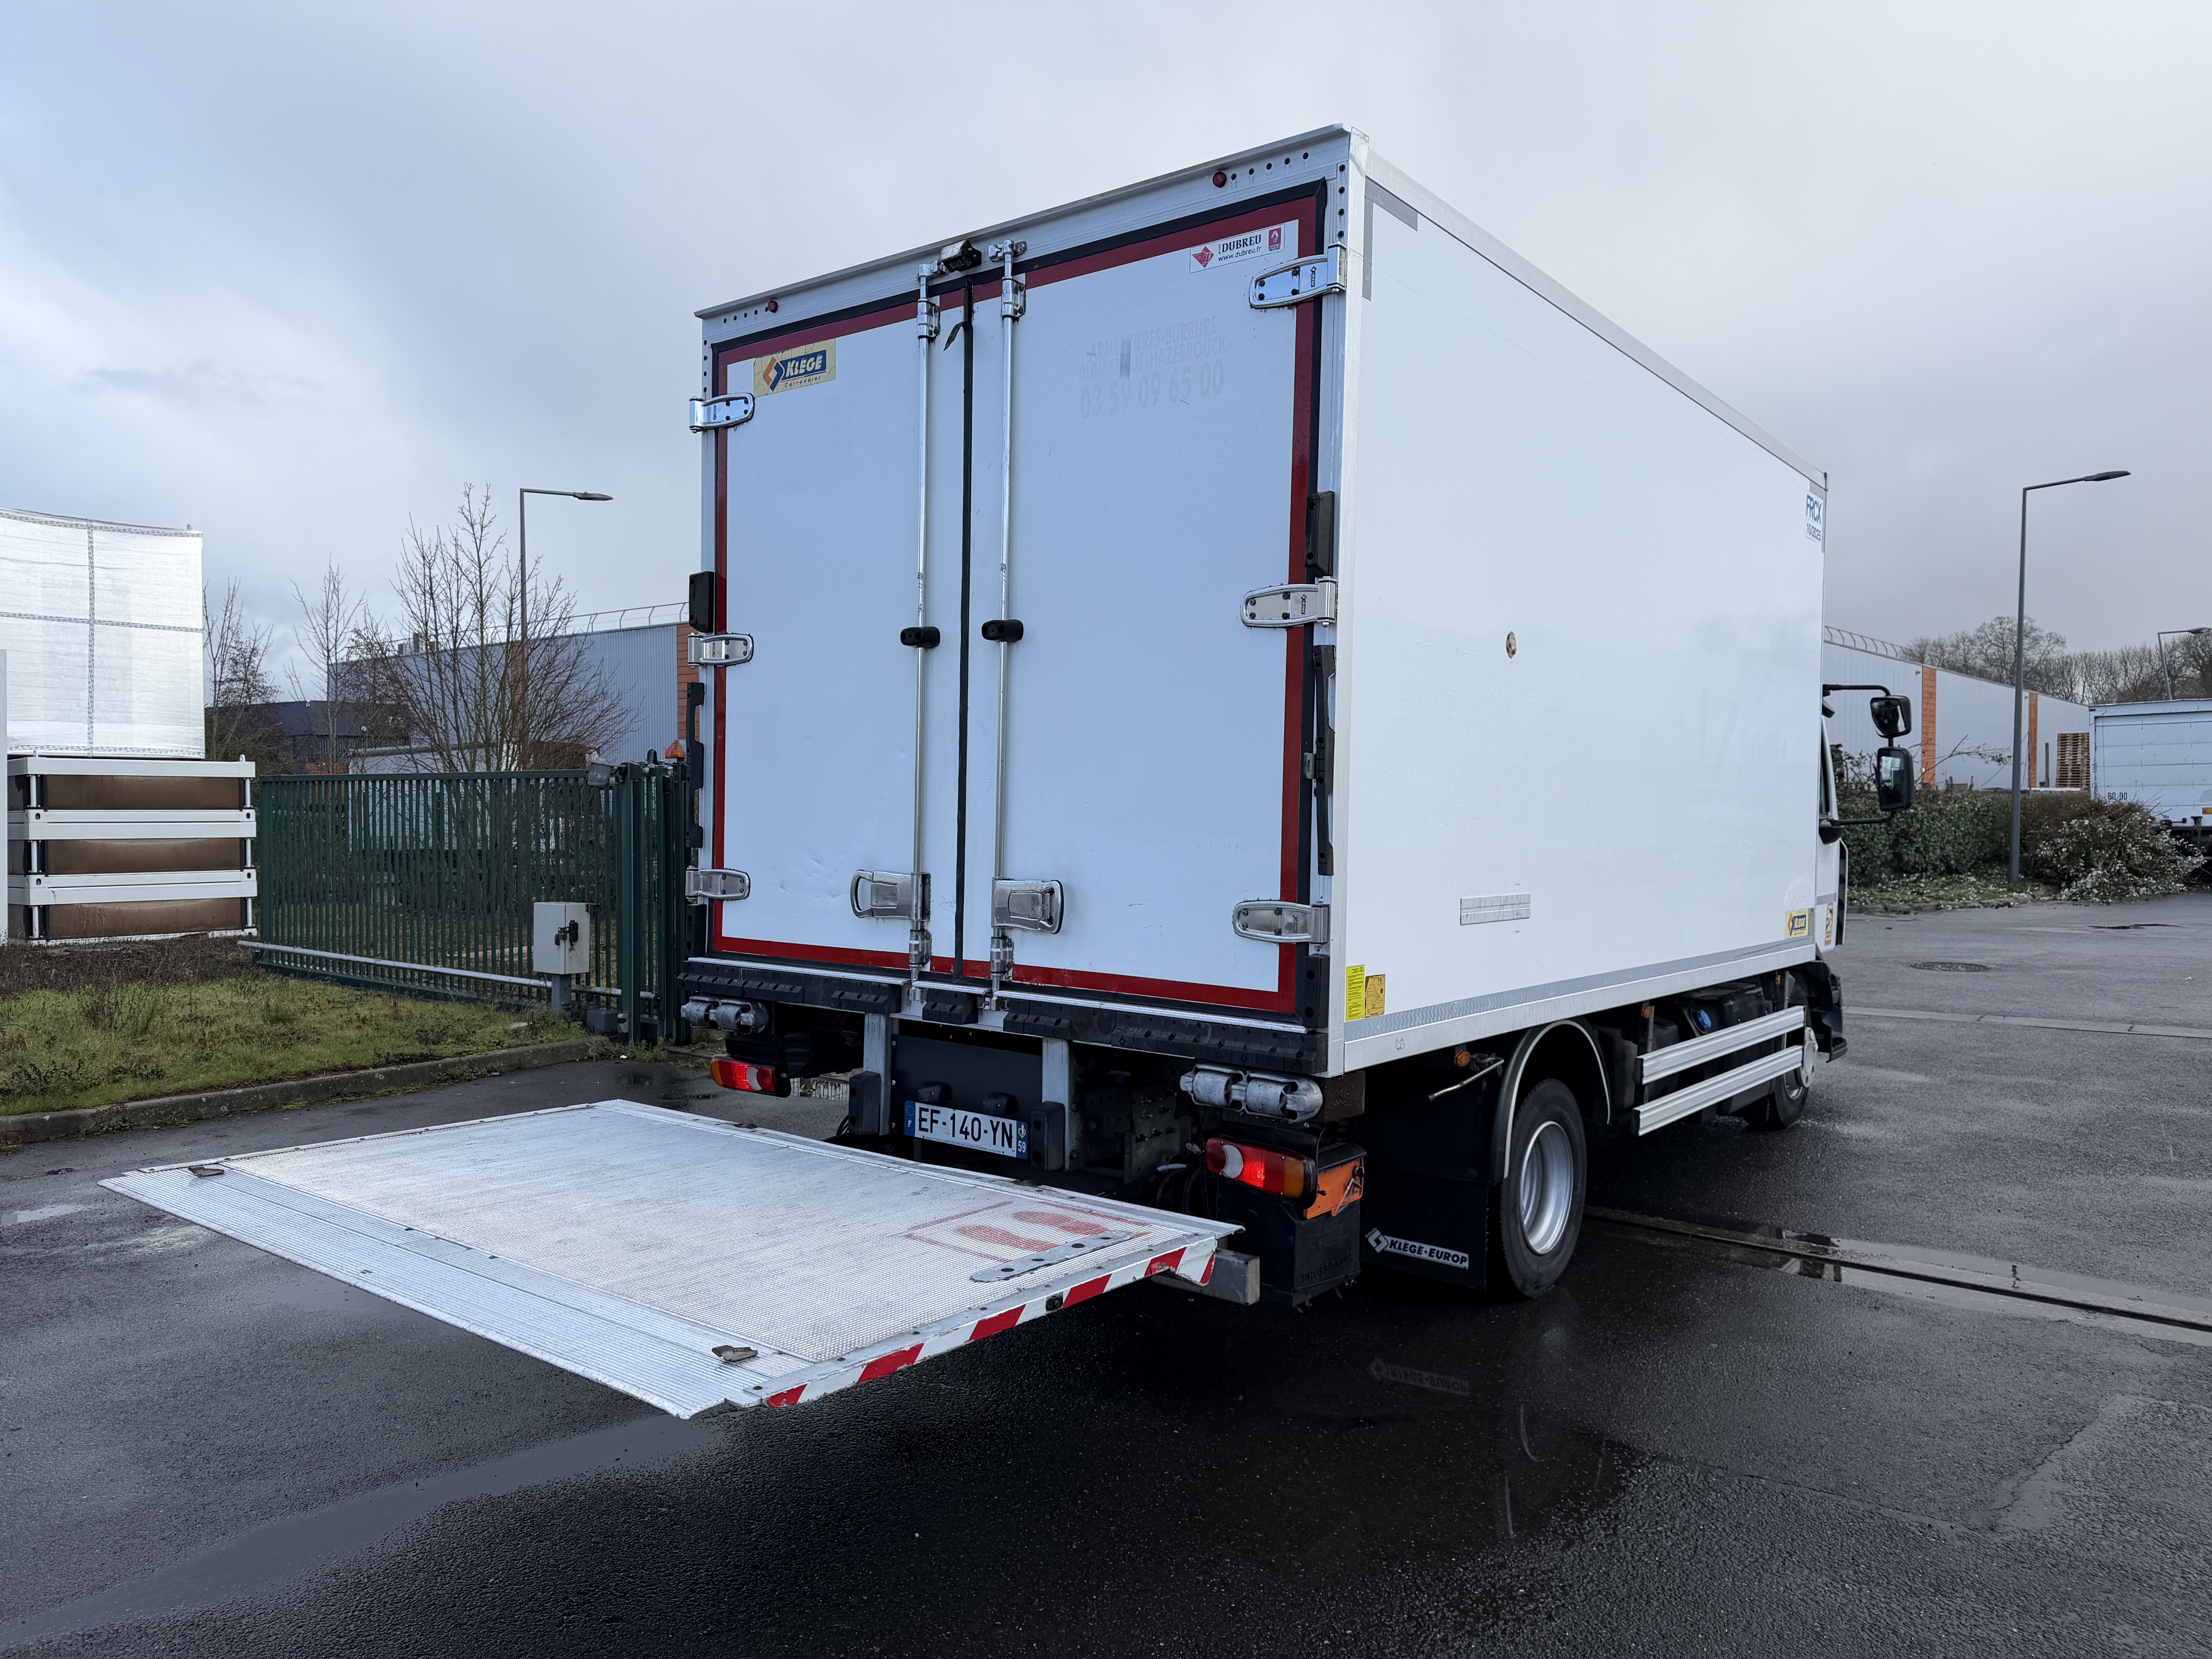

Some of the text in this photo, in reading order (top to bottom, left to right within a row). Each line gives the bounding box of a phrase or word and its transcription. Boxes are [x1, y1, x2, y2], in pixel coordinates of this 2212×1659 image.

[1221, 234, 1262, 253] DUBREU
[1218, 246, 1262, 261] www.dubreu.fr
[785, 376, 821, 388] Carrossier
[1138, 371, 1161, 409] 09
[1169, 365, 1192, 404] 65
[1200, 359, 1224, 398] 00
[1806, 494, 1822, 525] FRCX
[918, 1107, 1013, 1149] EF-140-YN
[1017, 1140, 1026, 1153] 59
